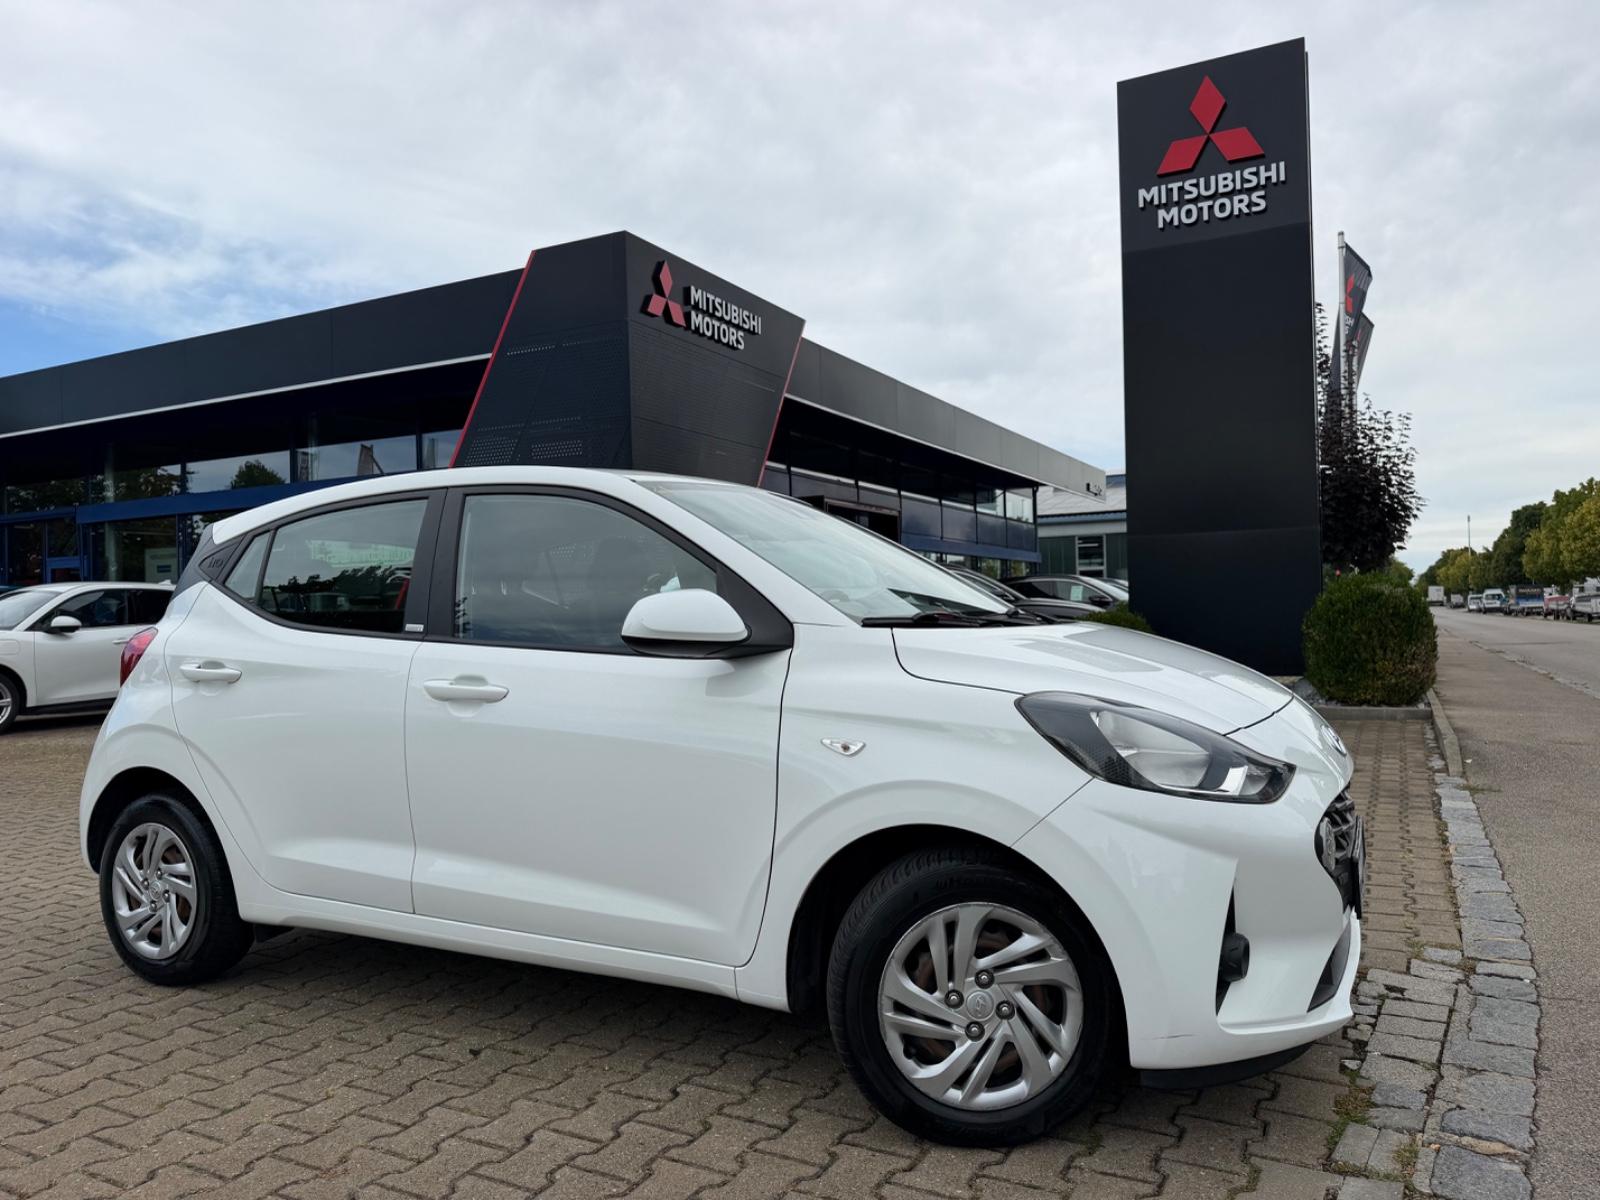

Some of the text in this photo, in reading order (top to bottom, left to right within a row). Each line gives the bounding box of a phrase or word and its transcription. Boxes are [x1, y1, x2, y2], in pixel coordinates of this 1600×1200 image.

[1137, 161, 1286, 208] MITSUBISHI
[1157, 190, 1267, 229] MOTORS
[690, 285, 762, 335] MITSUBISHI
[690, 310, 745, 350] MOTORS
